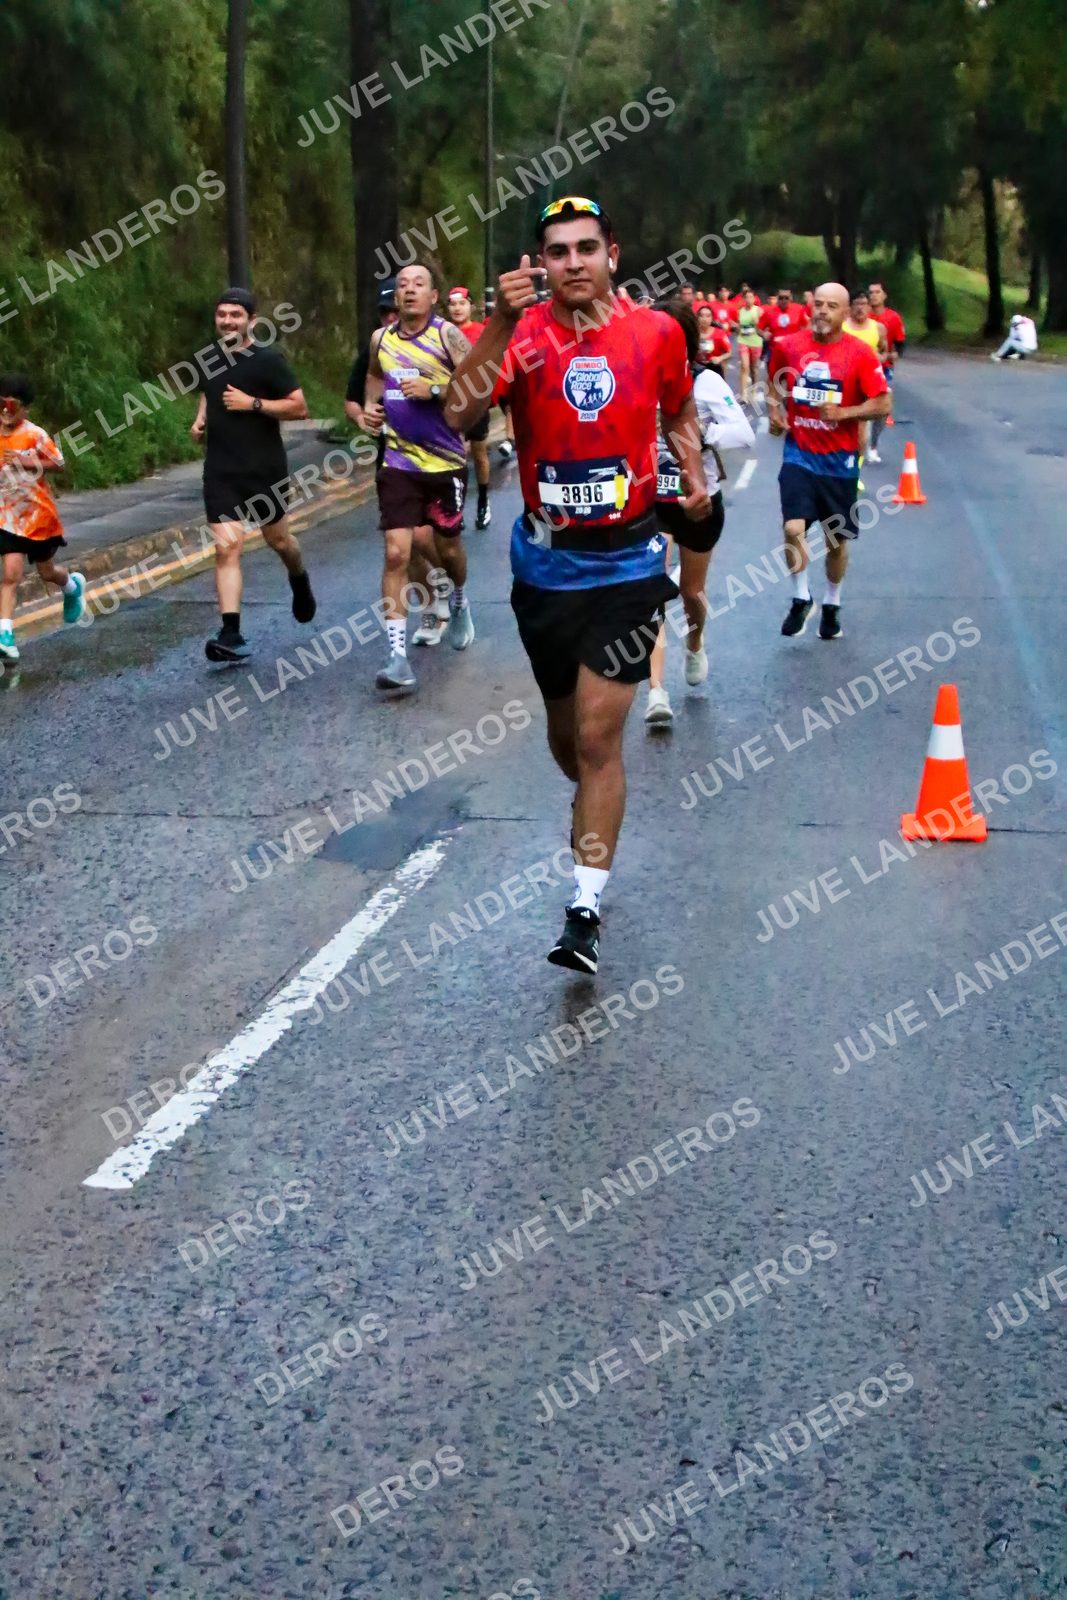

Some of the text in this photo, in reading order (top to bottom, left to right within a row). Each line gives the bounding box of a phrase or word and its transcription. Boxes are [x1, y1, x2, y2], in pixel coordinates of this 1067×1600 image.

[576, 372, 602, 382] Global
[571, 381, 592, 391] Race
[562, 484, 603, 504] 3896
